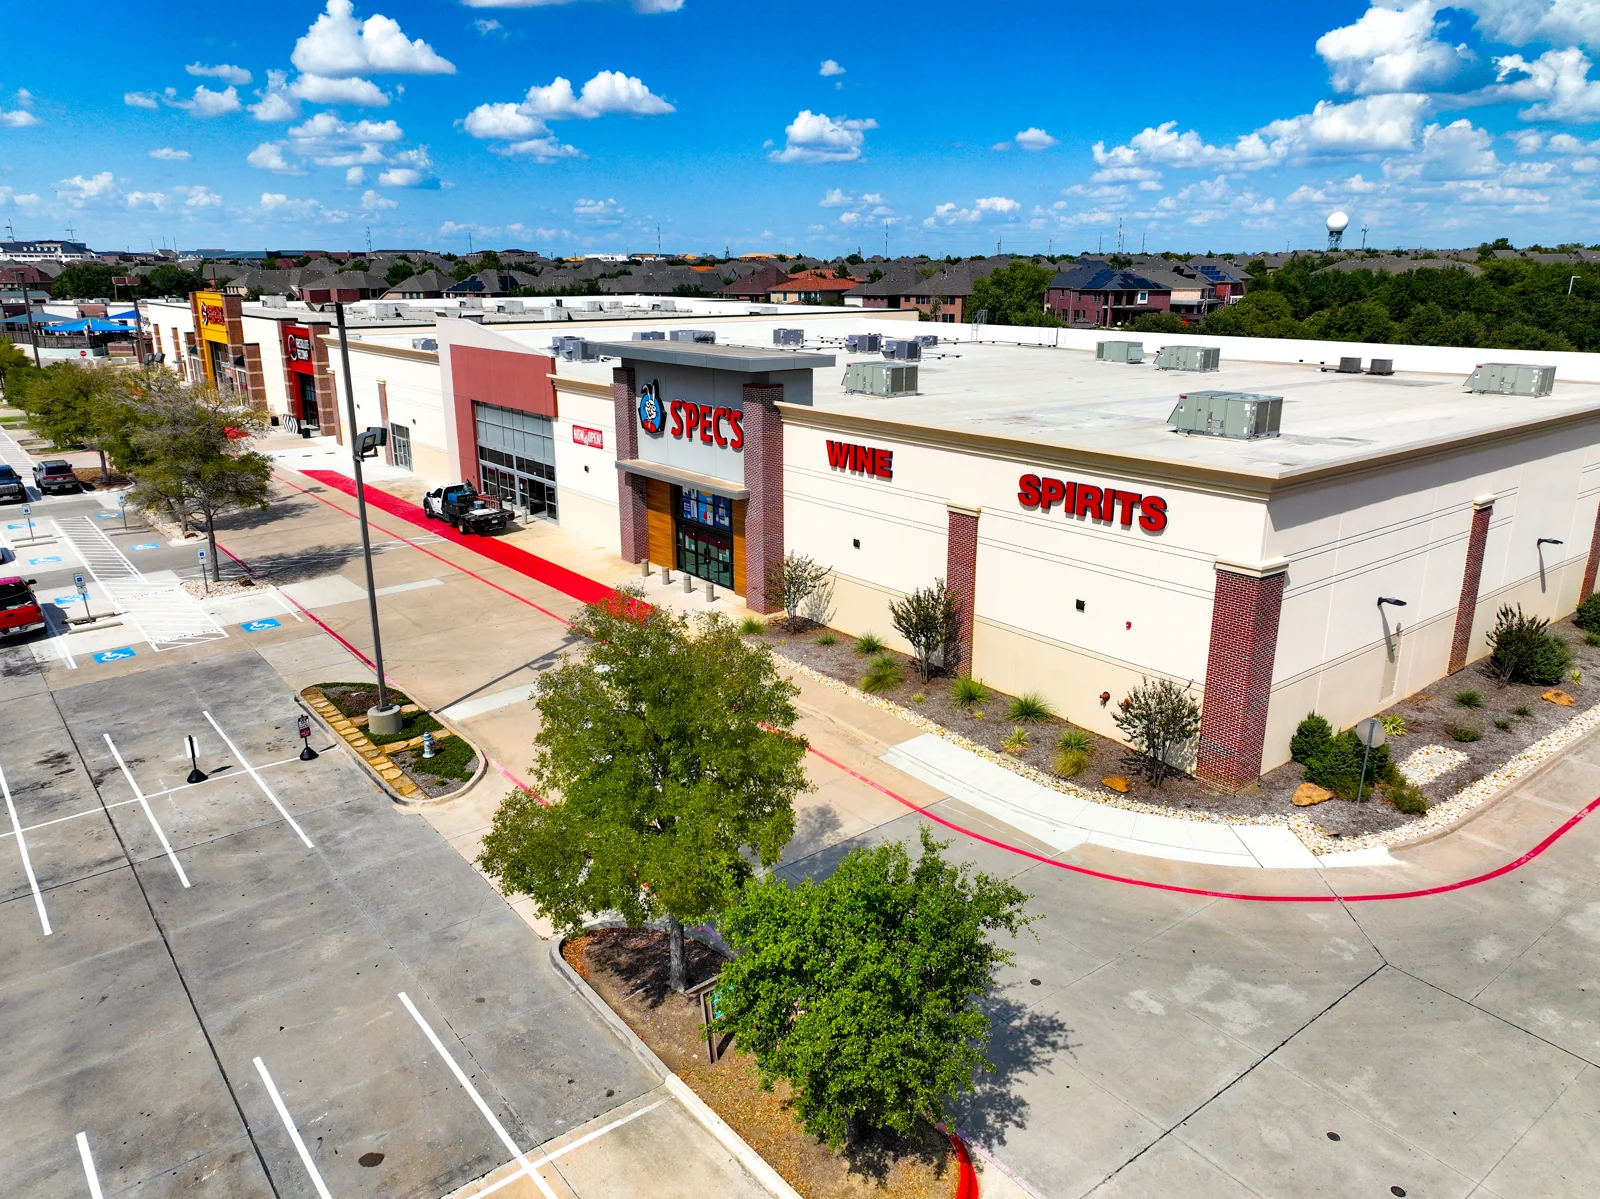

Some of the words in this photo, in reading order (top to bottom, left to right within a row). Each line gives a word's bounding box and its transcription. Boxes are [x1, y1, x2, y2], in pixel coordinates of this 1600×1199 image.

[670, 400, 743, 450] SPEC'S
[826, 440, 893, 478] WINE
[1018, 474, 1168, 531] SPIRITS
